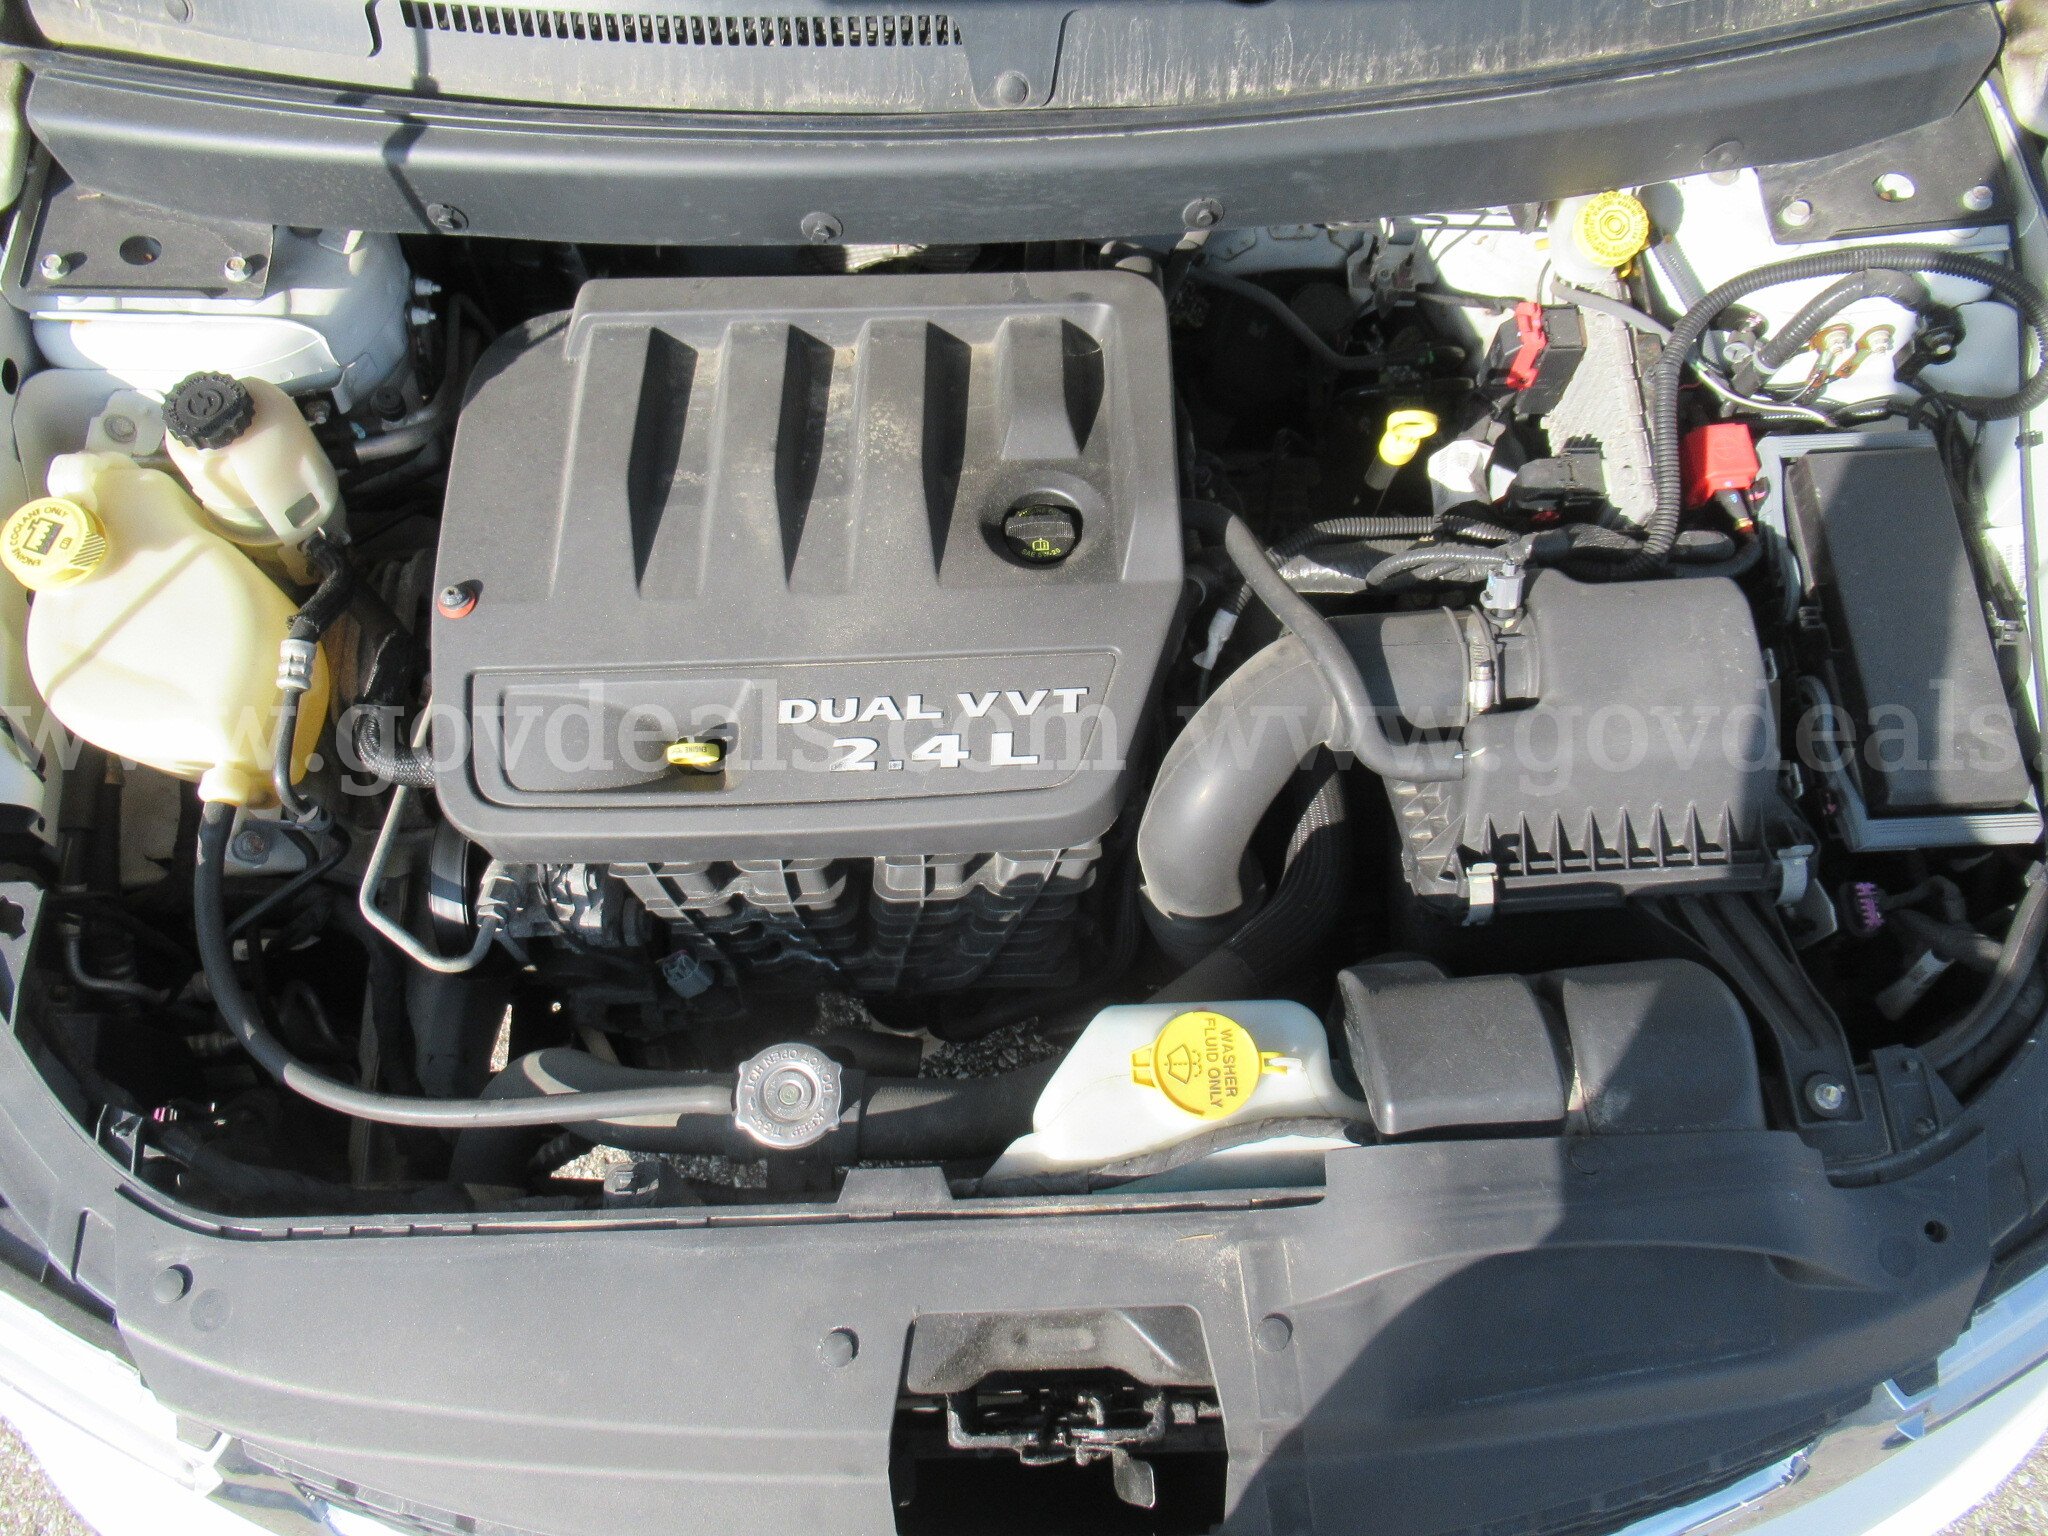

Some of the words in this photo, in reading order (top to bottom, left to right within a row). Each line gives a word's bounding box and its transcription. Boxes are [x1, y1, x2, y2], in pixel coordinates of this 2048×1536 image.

[10, 508, 40, 546] COOLANT
[44, 506, 68, 518] ONLY
[12, 547, 41, 566] ENGINE
[778, 694, 944, 724] DUAL
[957, 687, 1089, 717] VVT
[829, 733, 971, 772] 2.4
[990, 731, 1040, 767] L
[763, 1049, 798, 1067] OPEN
[1204, 1017, 1219, 1063] FLUID
[1220, 1028, 1238, 1097] WASHER
[821, 1074, 833, 1093] DO
[1207, 1067, 1223, 1108] ONLY
